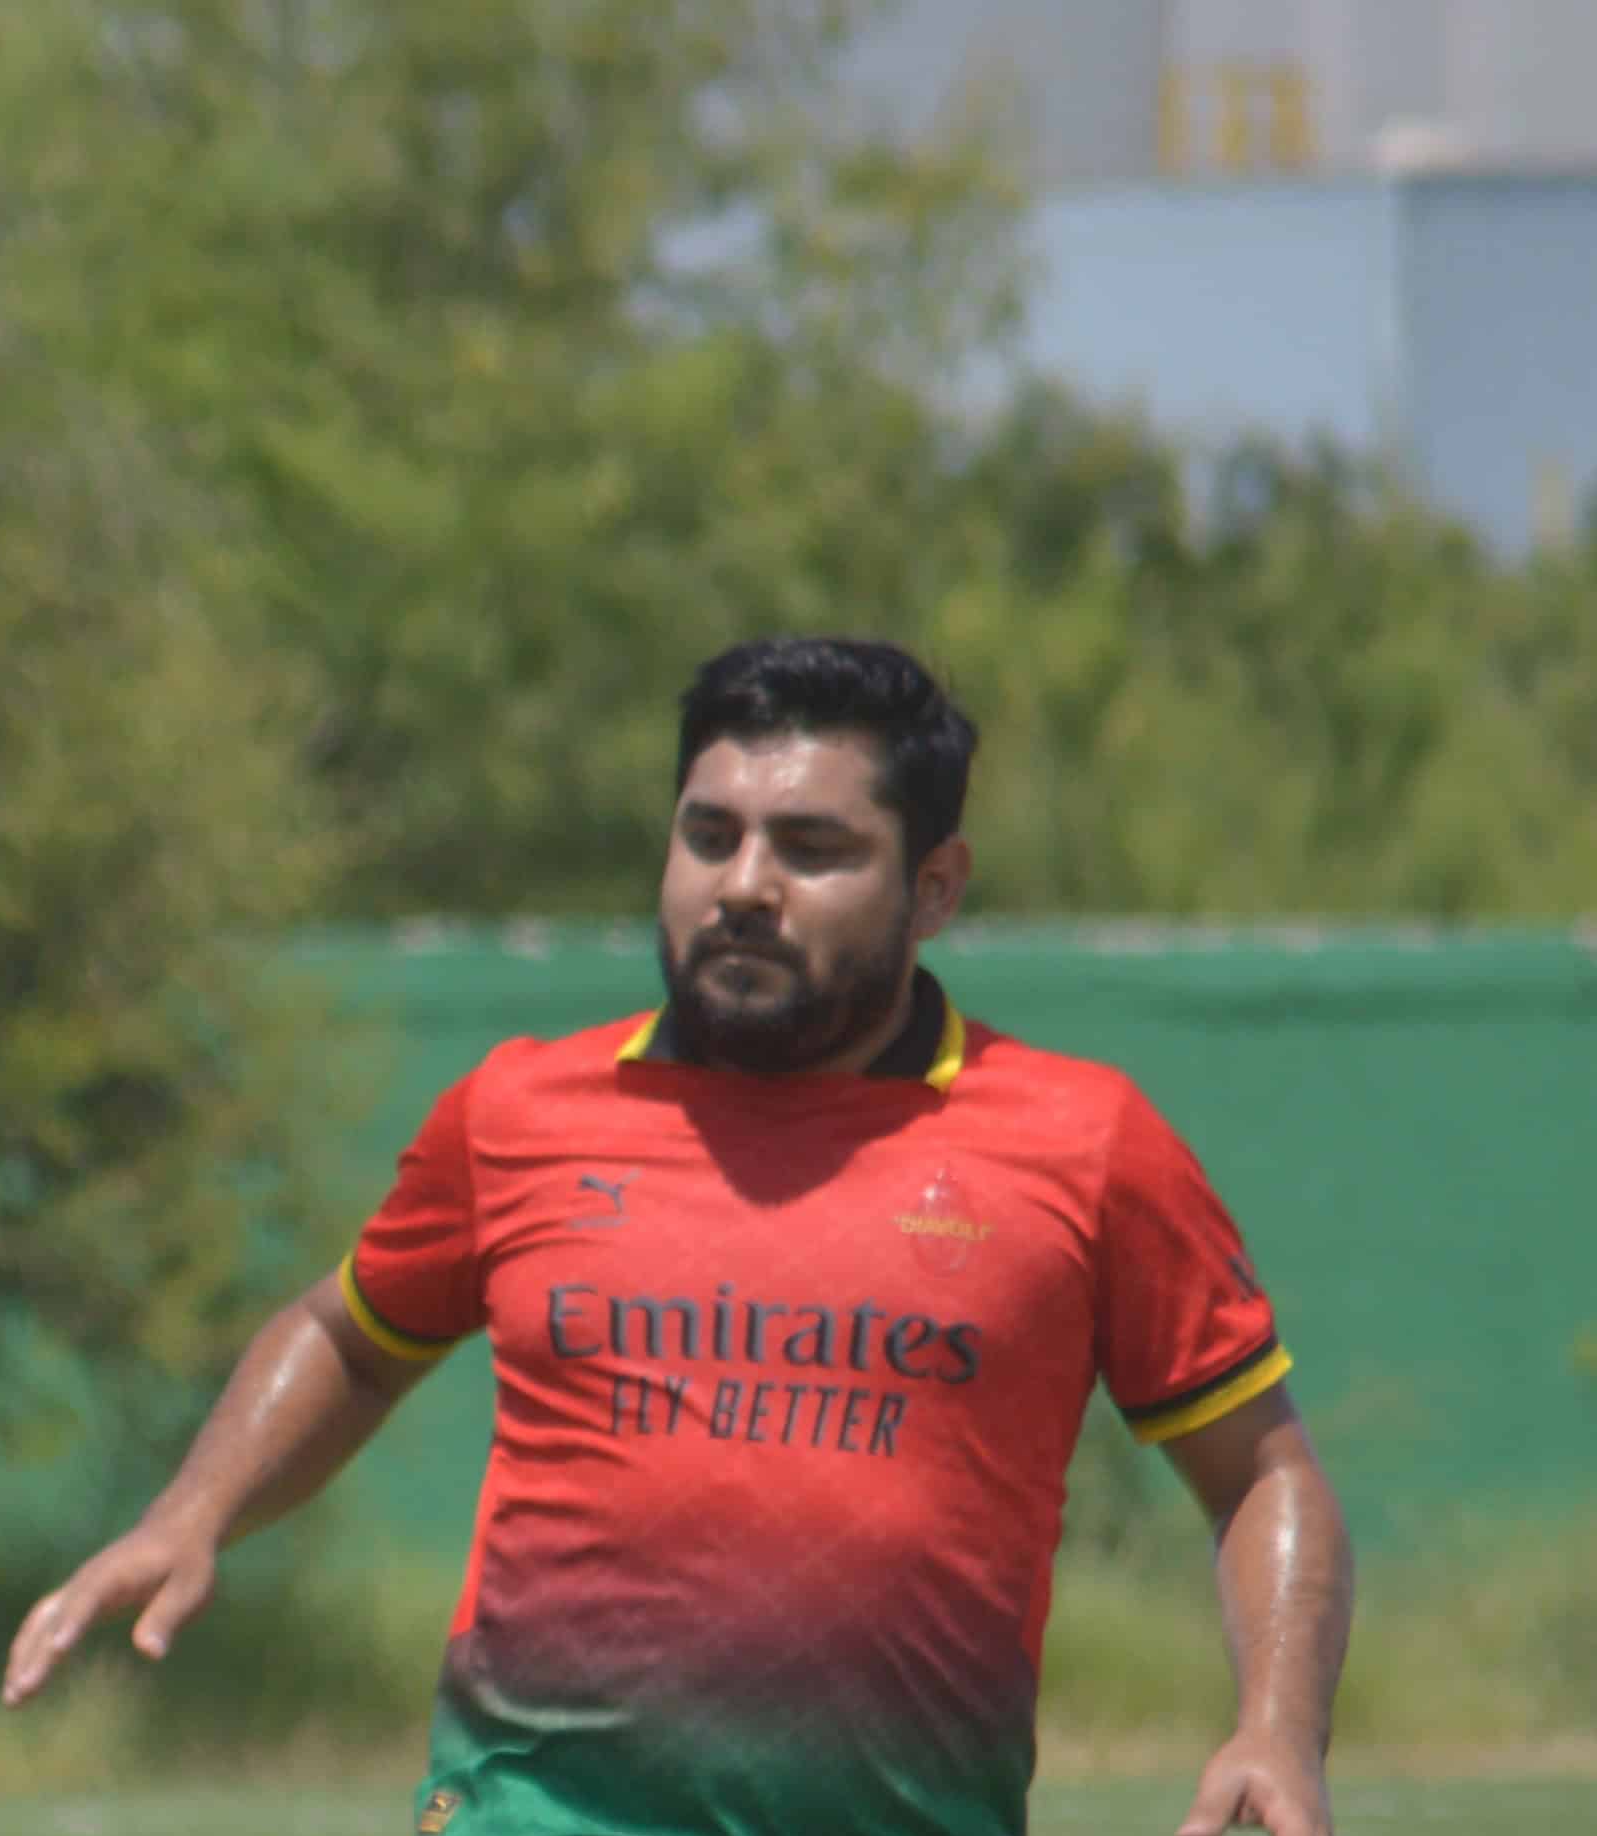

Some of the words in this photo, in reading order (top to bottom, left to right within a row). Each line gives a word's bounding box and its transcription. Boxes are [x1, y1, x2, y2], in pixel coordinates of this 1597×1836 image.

[548, 1281, 983, 1385] Emirates
[610, 1374, 691, 1436] FLY
[709, 1377, 909, 1457] BETTER
